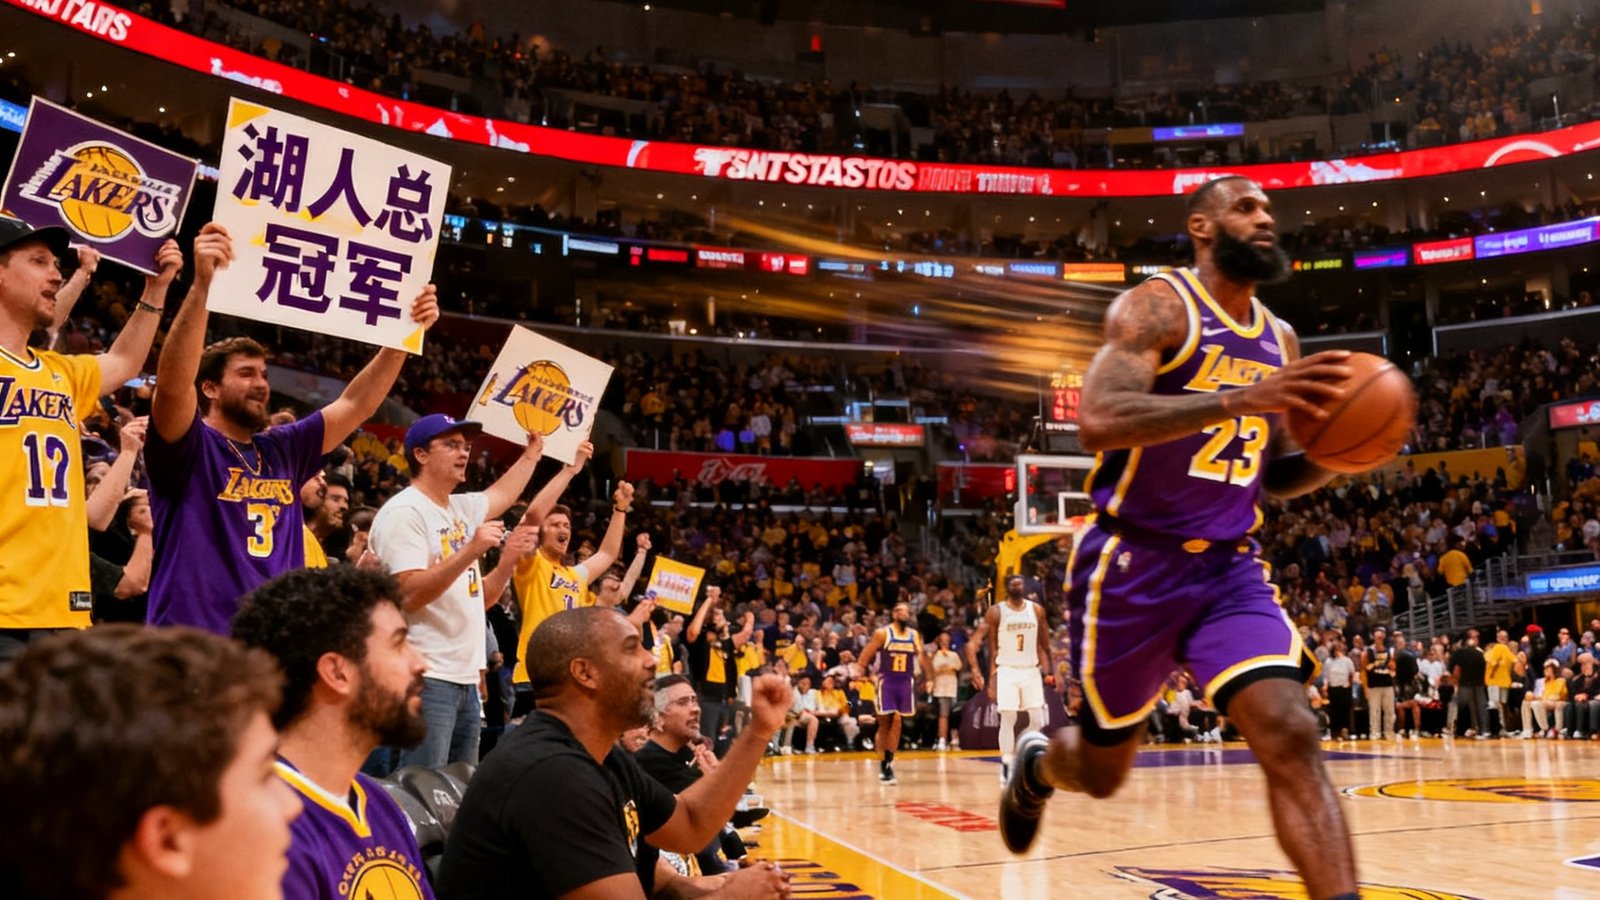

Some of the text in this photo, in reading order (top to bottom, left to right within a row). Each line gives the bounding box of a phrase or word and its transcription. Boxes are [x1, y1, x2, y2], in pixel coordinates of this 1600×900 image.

[34, 154, 172, 232] LAKERS
[232, 123, 433, 243] 湖人总
[256, 223, 413, 326] 冠军
[1187, 415, 1269, 487] 23
